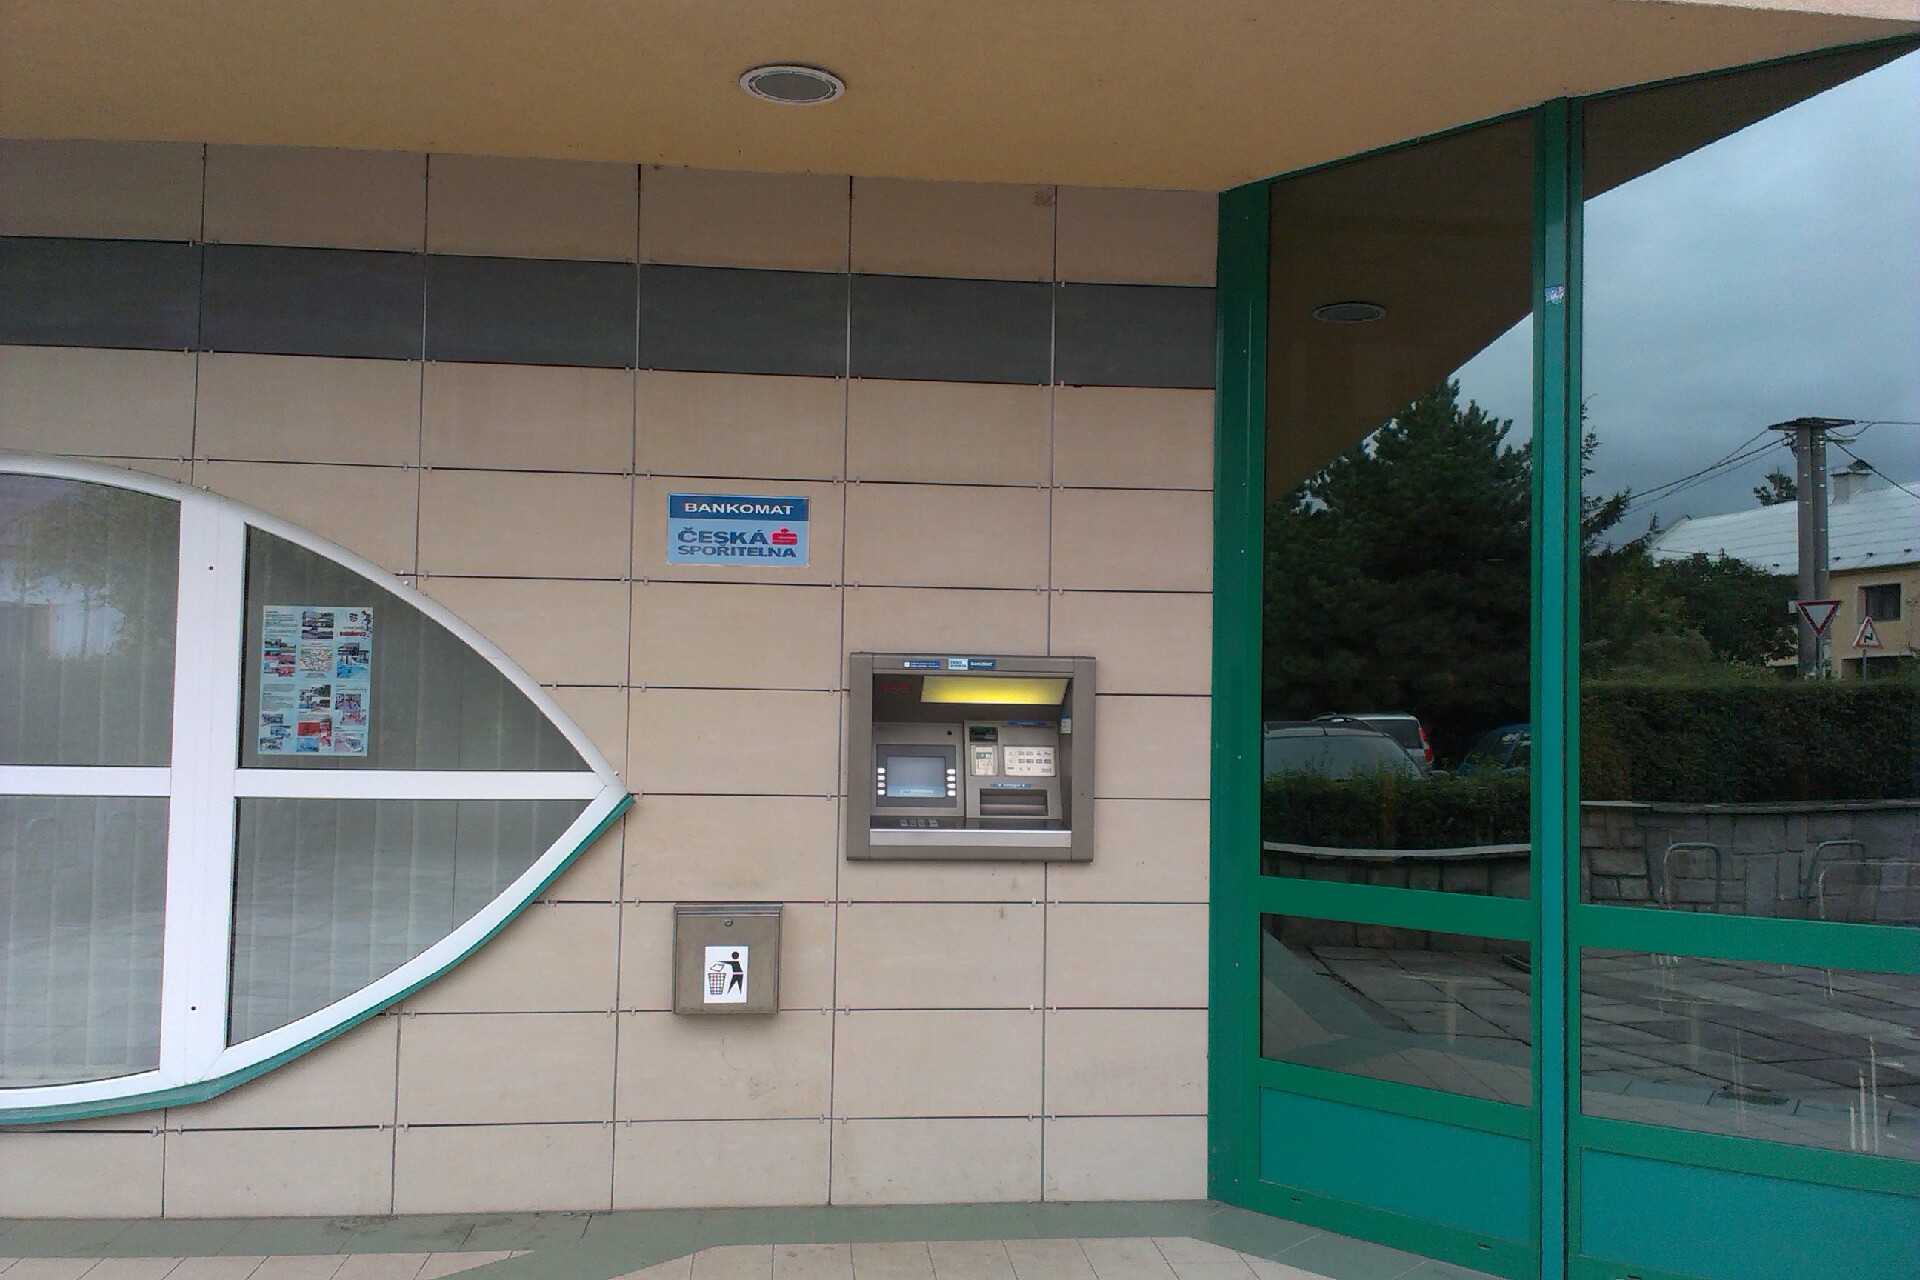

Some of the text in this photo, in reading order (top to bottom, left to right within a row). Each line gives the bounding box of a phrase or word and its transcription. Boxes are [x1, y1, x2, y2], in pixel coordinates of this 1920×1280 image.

[684, 502, 794, 515] BANKOMAT
[677, 526, 769, 545] ČESKÁ
[677, 544, 797, 558] SPOŘITELNA
